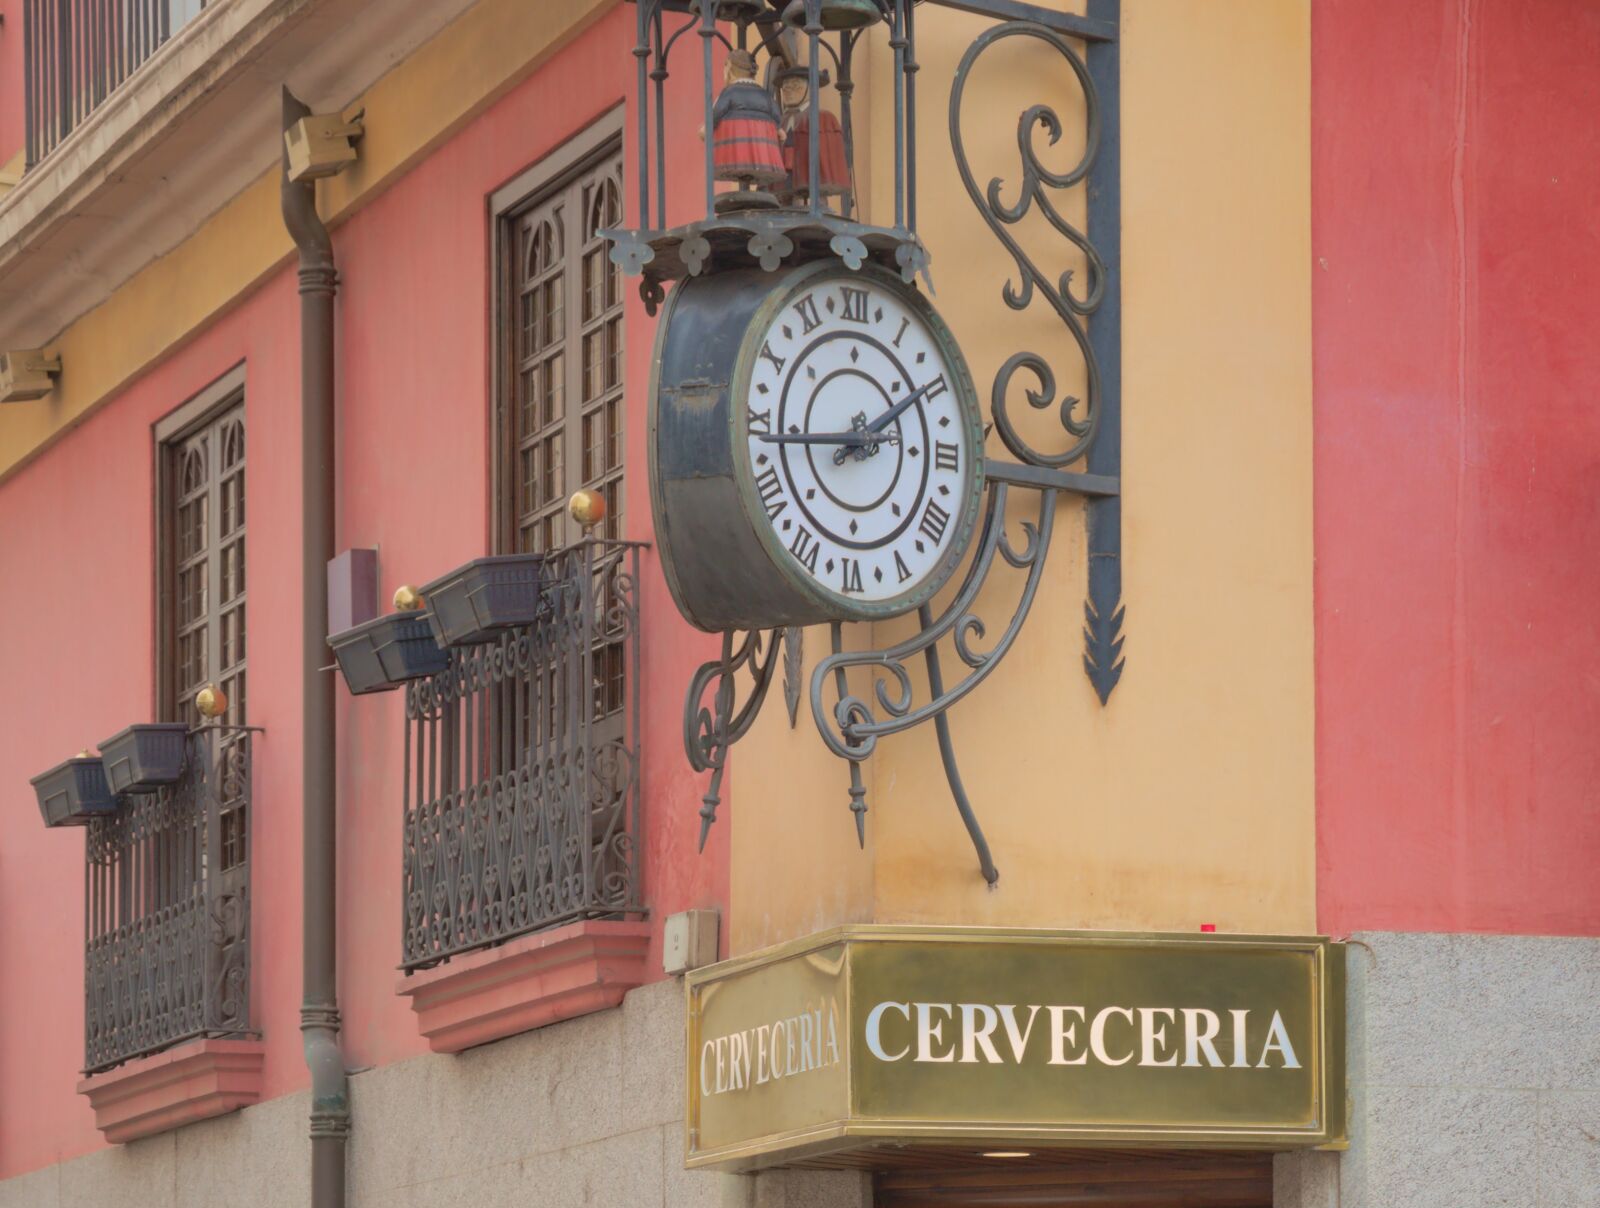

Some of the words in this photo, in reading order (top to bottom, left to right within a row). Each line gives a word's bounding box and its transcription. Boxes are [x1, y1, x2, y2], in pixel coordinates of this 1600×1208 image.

[793, 293, 822, 335] XI
[840, 286, 870, 324] XII
[893, 316, 910, 348] I
[759, 340, 786, 375] X
[922, 372, 948, 403] II
[748, 405, 770, 436] IX
[935, 439, 959, 473] III
[755, 465, 788, 524] VIII
[919, 497, 950, 547] IIII
[789, 524, 819, 574] VII
[894, 550, 912, 583] V
[841, 557, 865, 592] VI
[701, 1007, 841, 1096] CERVECERIA
[864, 1001, 1303, 1070] CERVECERIA
